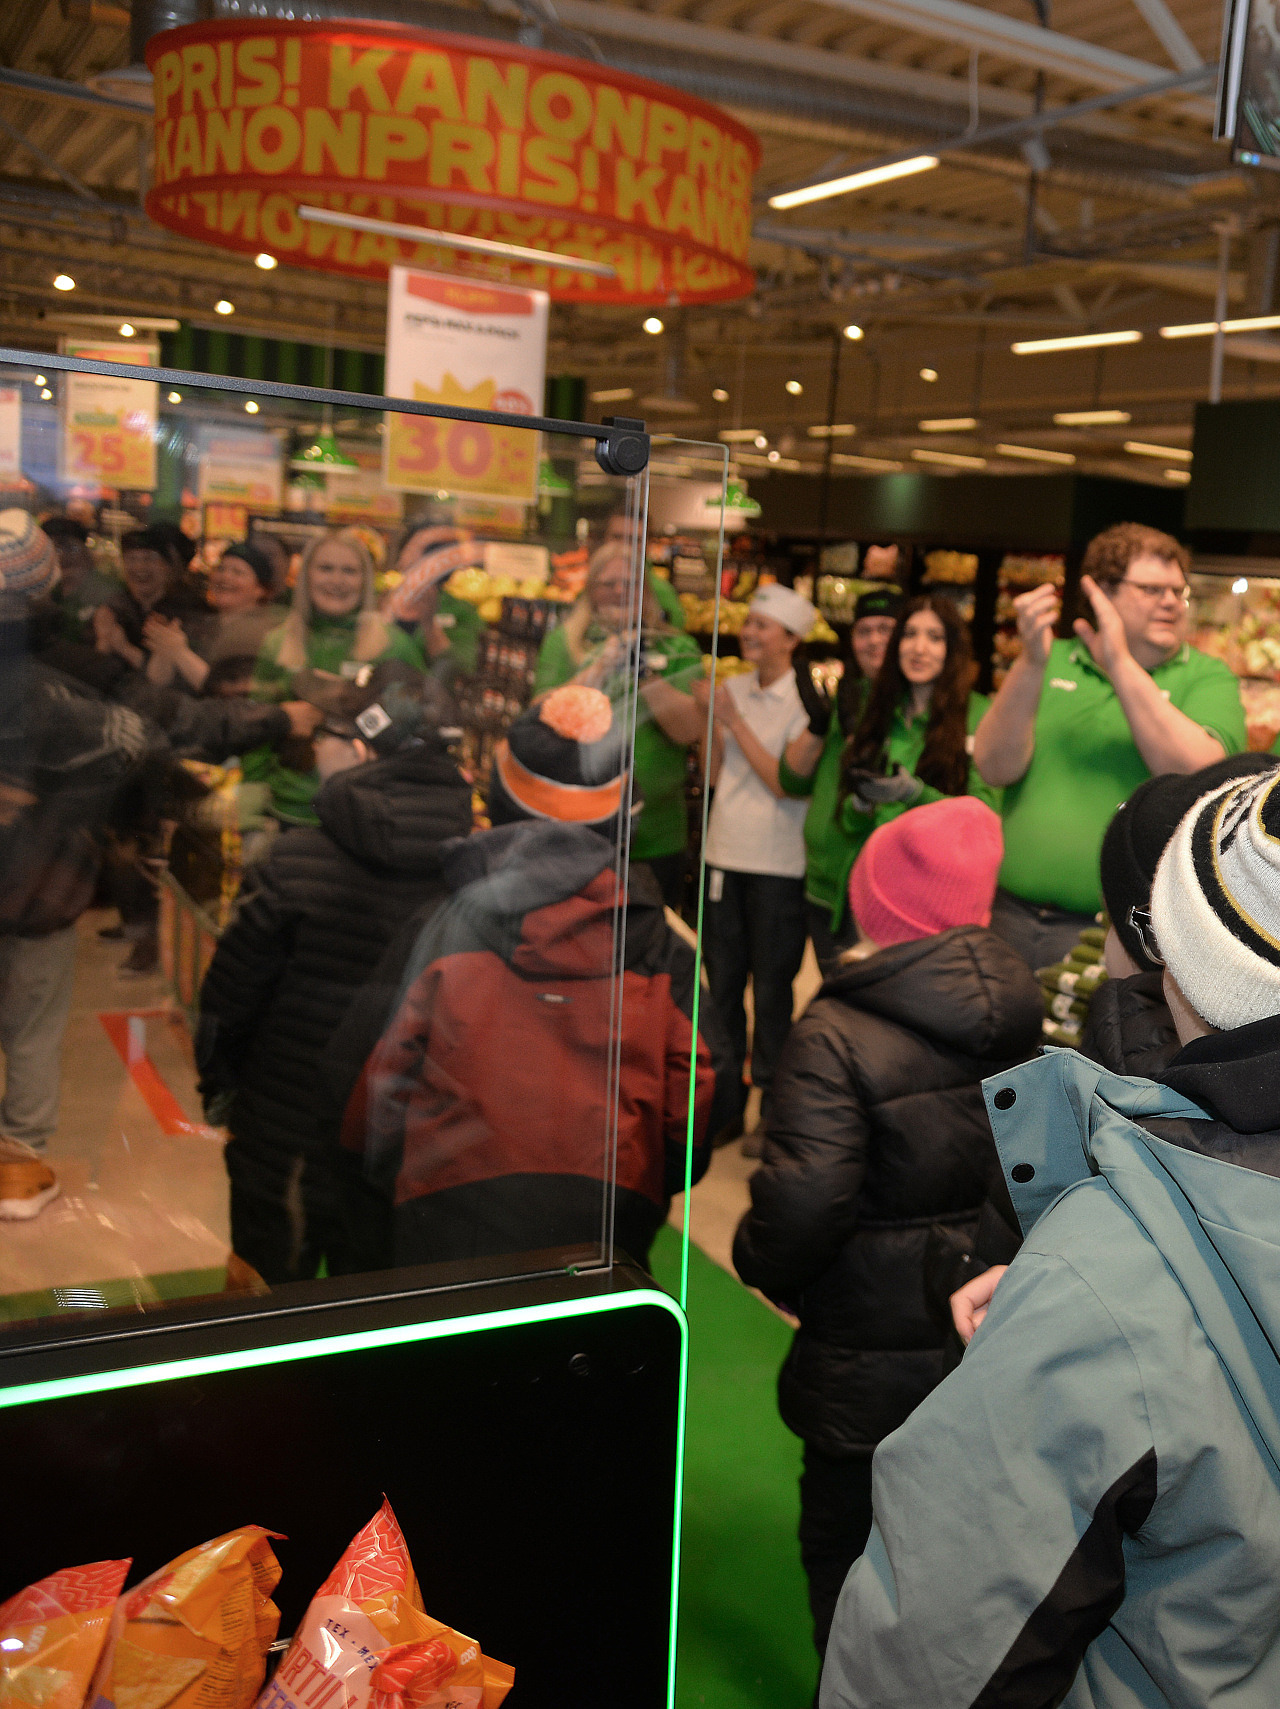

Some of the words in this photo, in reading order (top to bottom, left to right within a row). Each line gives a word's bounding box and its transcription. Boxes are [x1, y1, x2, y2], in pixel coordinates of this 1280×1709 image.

[155, 105, 599, 211] KANONPRIS!
[73, 432, 127, 473] 25
[396, 411, 495, 479] 30
[325, 1618, 350, 1639] TEX
